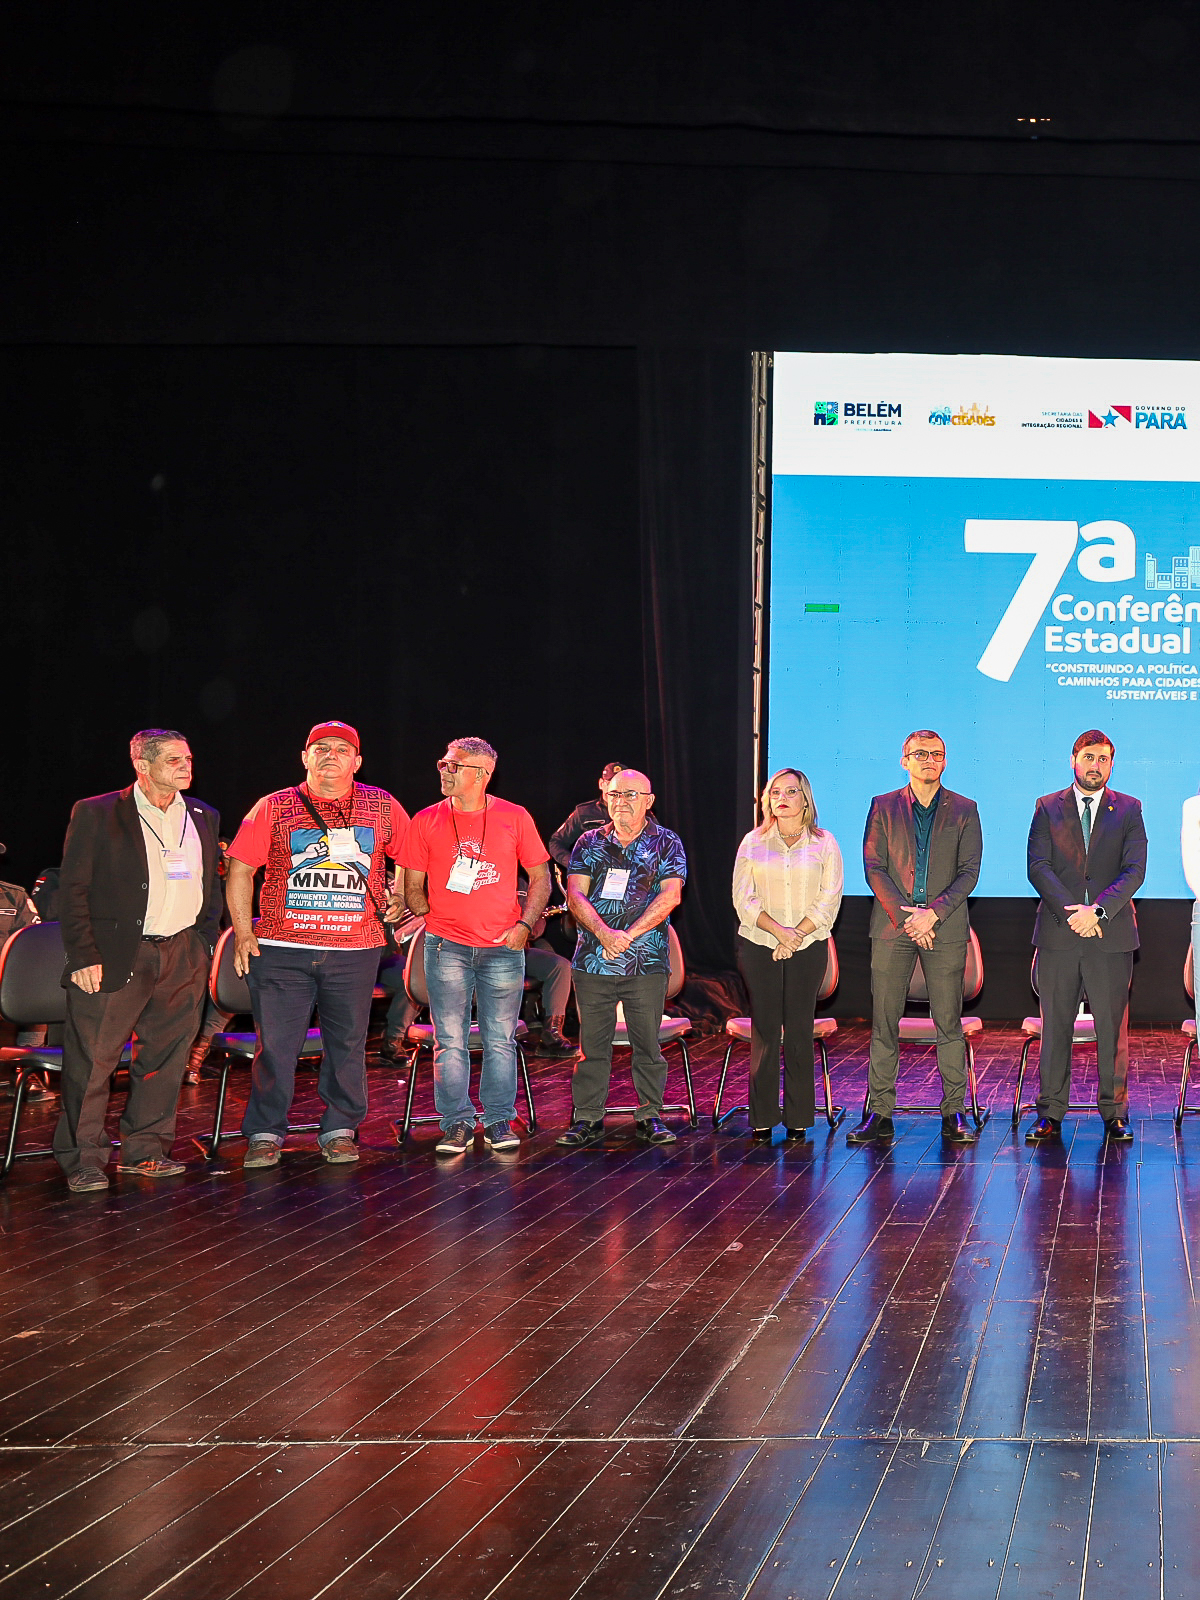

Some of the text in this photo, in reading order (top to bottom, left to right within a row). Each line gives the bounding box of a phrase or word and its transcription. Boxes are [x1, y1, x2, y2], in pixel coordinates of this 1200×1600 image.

[844, 401, 902, 418] BELÉM
[1044, 625, 1190, 655] Estadual
[1135, 664, 1146, 674] A
[1147, 662, 1198, 675] POLÍTICA
[1057, 676, 1120, 687] CAMINHOS
[1122, 677, 1153, 687] PARA
[1106, 688, 1187, 700] SUSTENTÁVEIS
[1190, 690, 1198, 701] E
[293, 873, 363, 890] MNLM
[288, 892, 328, 900] MOVIMENTO
[288, 899, 296, 907] DE
[313, 900, 332, 908] PELA
[285, 911, 363, 923] Ocupar, resistir
[293, 922, 352, 932] para morar
